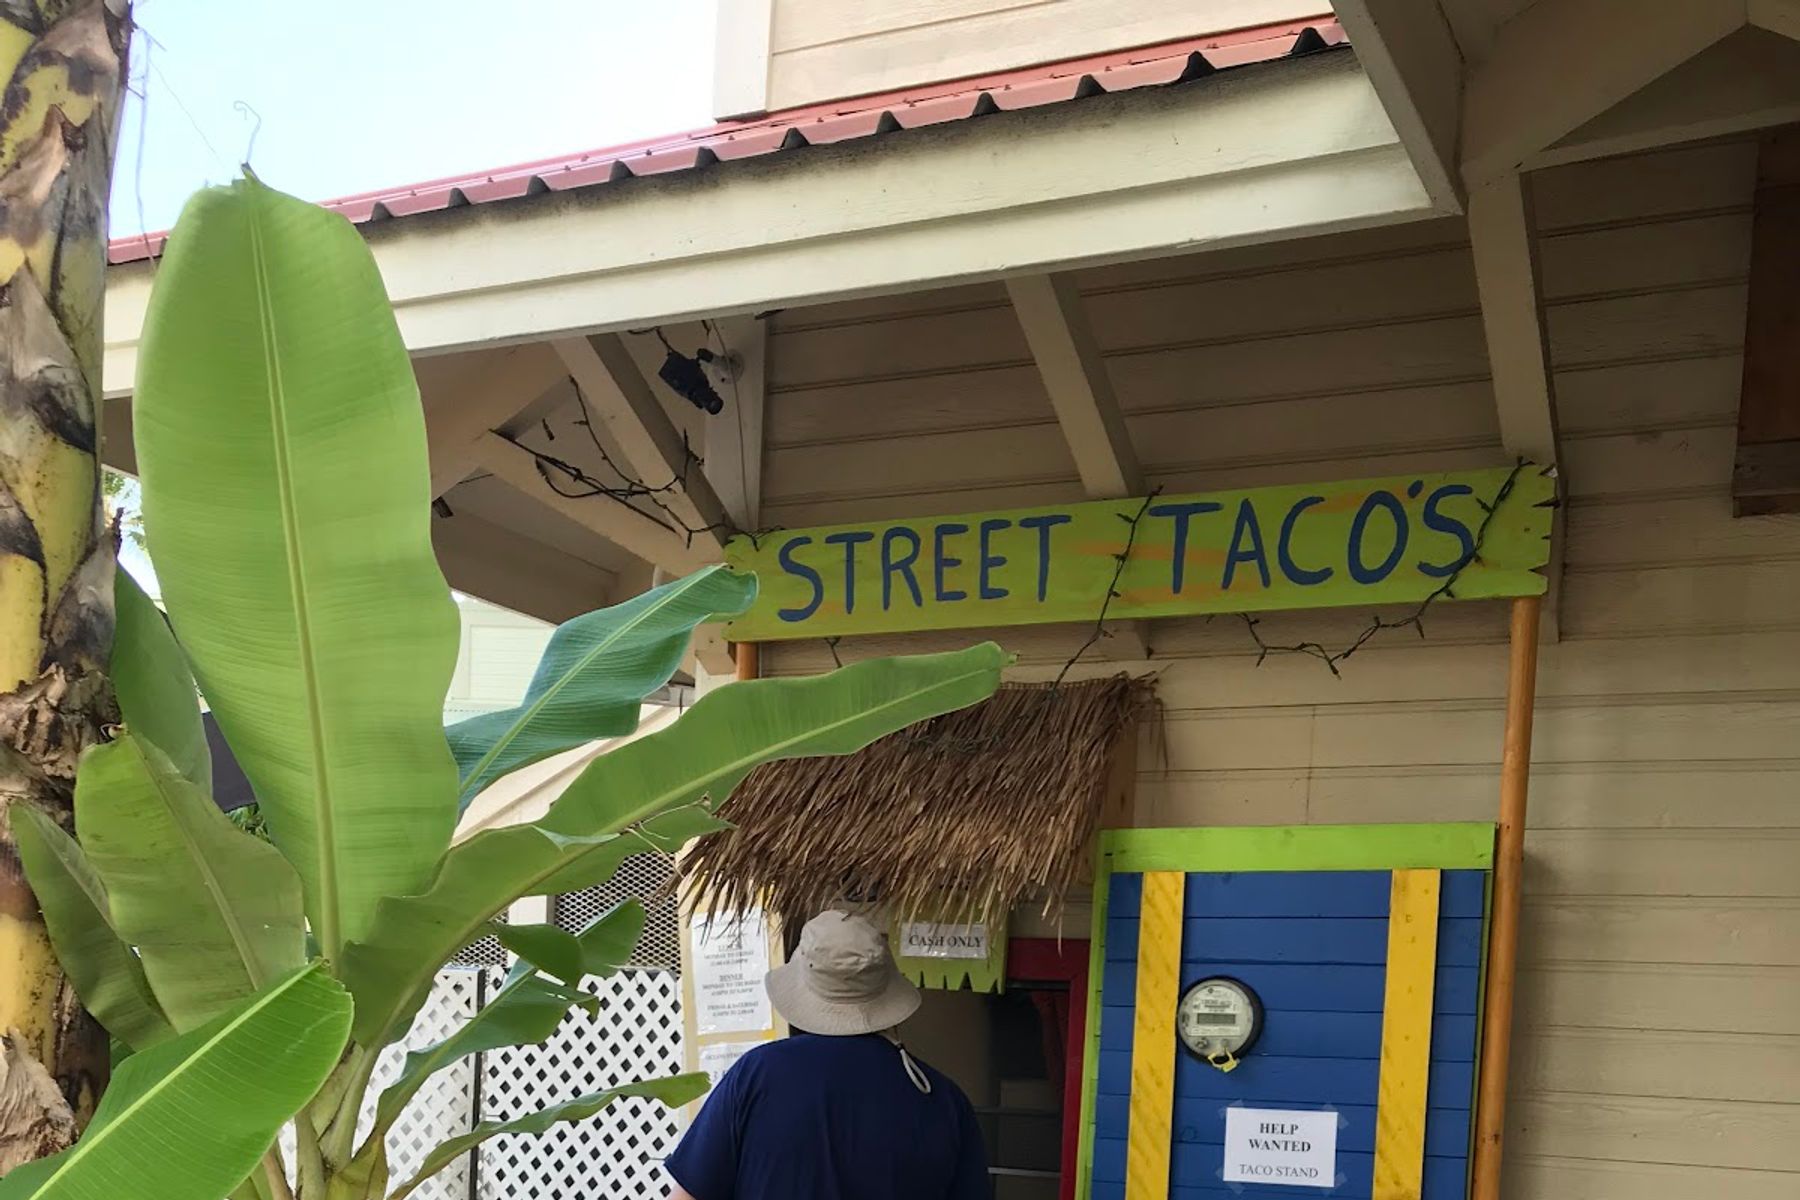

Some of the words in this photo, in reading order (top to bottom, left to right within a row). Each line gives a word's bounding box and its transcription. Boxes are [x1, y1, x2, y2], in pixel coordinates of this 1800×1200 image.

[777, 514, 1071, 623] STREET
[1148, 480, 1476, 595] TACO'S
[908, 934, 944, 947] CASH
[947, 935, 983, 948] ONLY
[1259, 1122, 1299, 1135] HELP
[1249, 1138, 1311, 1152] WANTED
[1239, 1163, 1274, 1176] TACO
[1275, 1166, 1319, 1179] STAND
